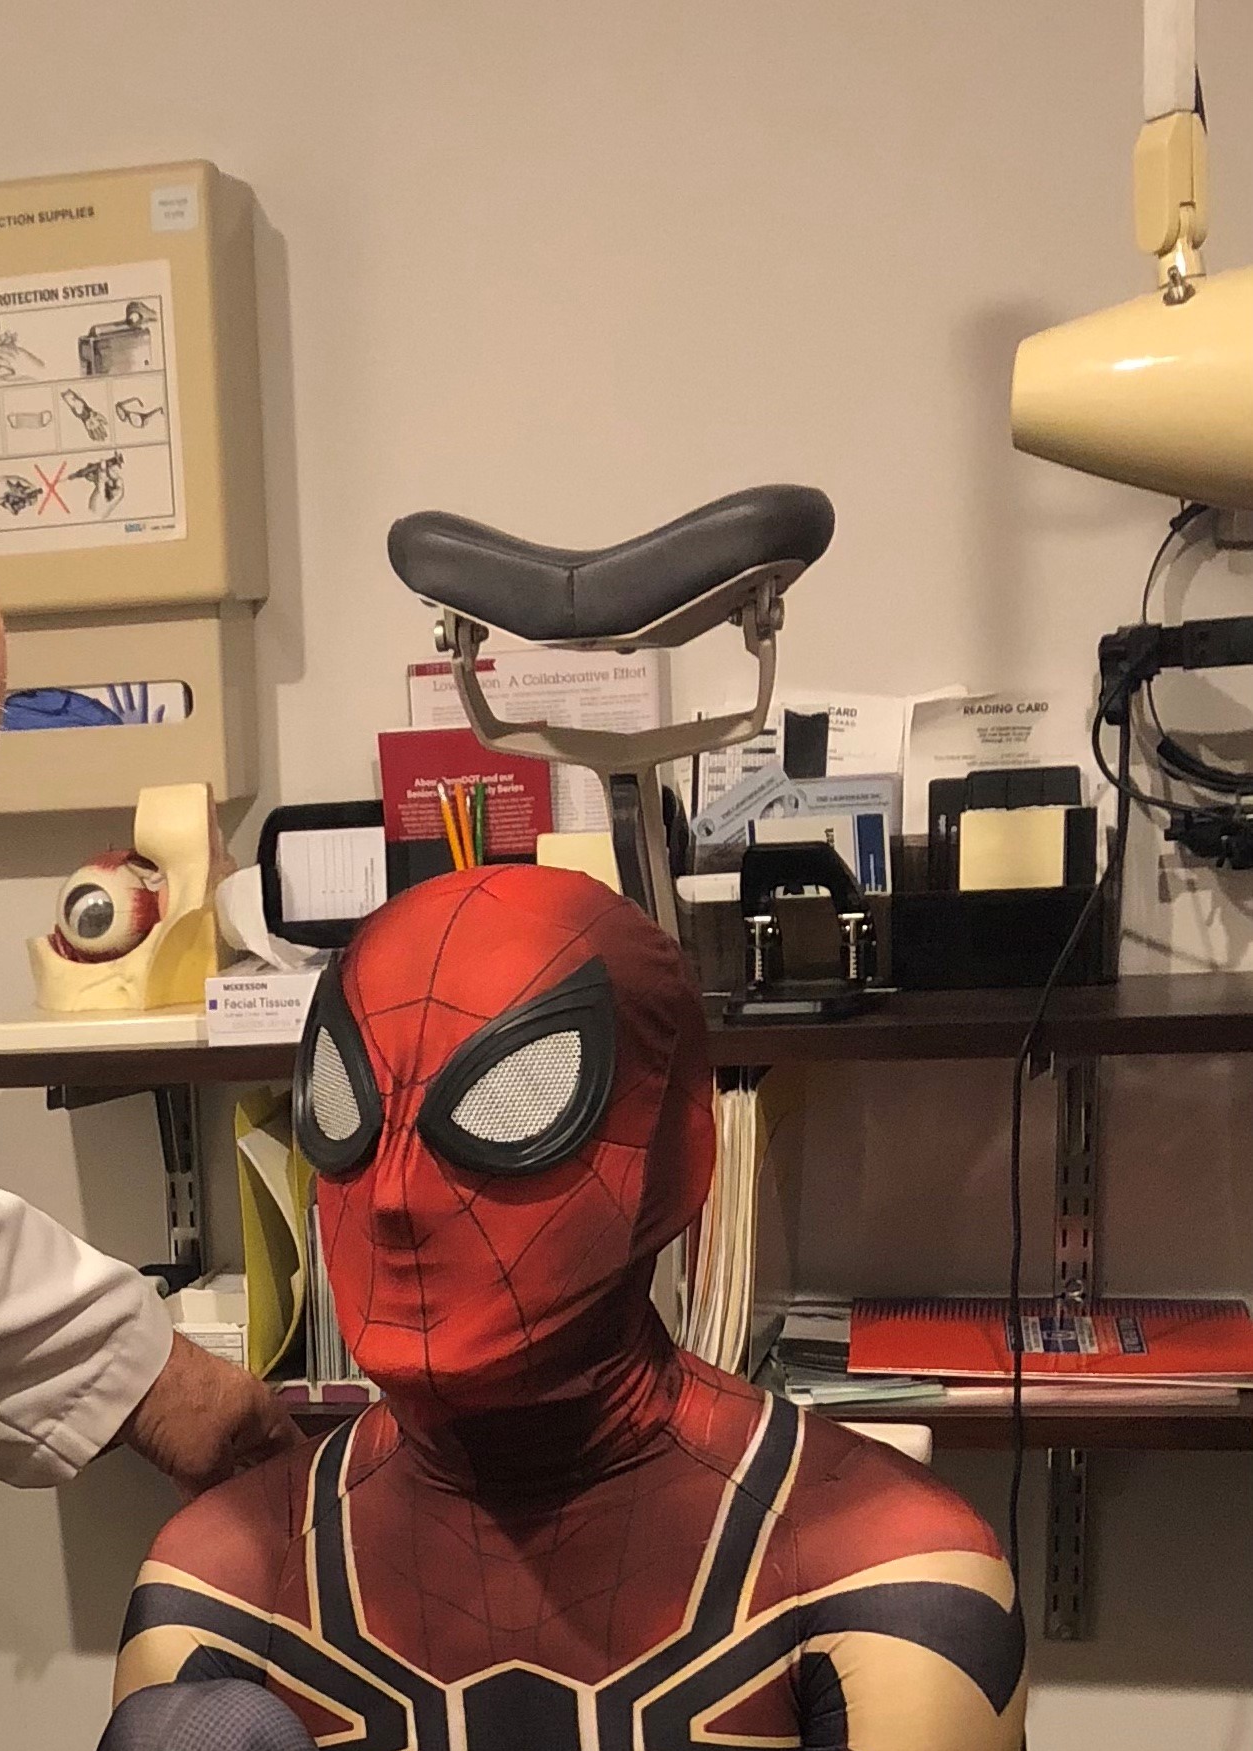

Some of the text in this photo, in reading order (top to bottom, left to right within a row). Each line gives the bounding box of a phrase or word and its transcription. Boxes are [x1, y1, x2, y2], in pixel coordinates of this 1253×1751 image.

[38, 206, 95, 223] SUPPLIES
[62, 282, 109, 300] SYSTEM
[509, 675, 519, 688] A
[522, 670, 609, 687] Collaborative
[613, 666, 646, 680] Effort
[829, 706, 857, 717] CARD
[963, 702, 1049, 715] READING CARD
[224, 997, 301, 1010] Facial Tissues
